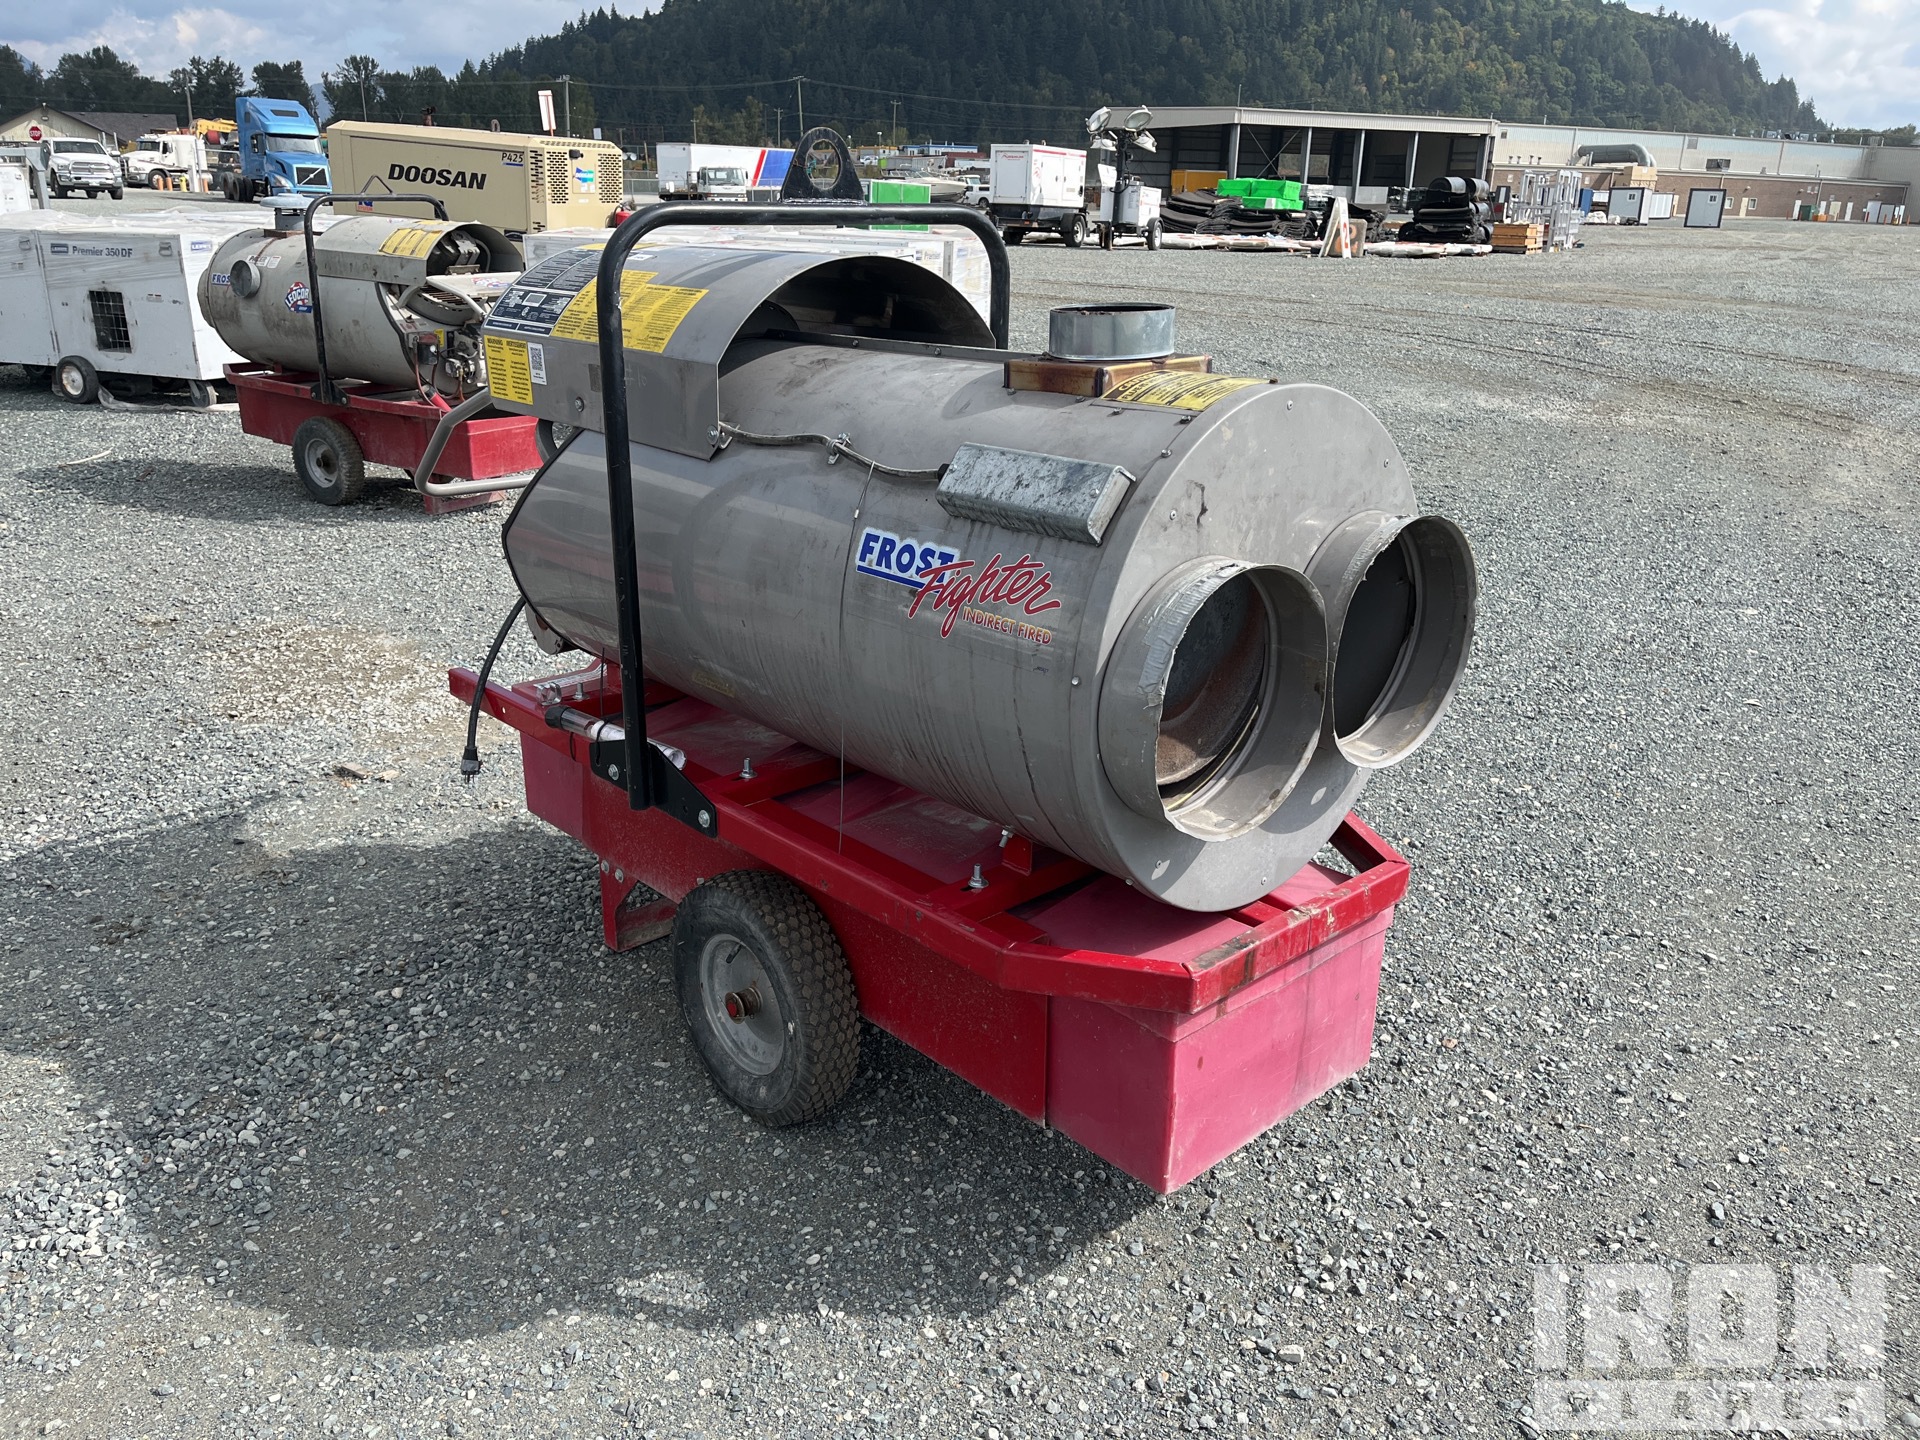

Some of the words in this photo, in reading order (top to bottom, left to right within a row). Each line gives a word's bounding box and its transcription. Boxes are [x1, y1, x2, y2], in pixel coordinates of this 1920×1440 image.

[501, 151, 524, 163] P425
[388, 163, 487, 190] DOOSAN
[72, 245, 103, 256] Premier
[212, 273, 231, 284] FROS
[284, 287, 310, 308] LEDCOR
[858, 532, 956, 584] FROST
[908, 553, 1061, 639] Fighter
[962, 606, 1017, 635] INDIRECT
[1018, 621, 1052, 645] FIRED
